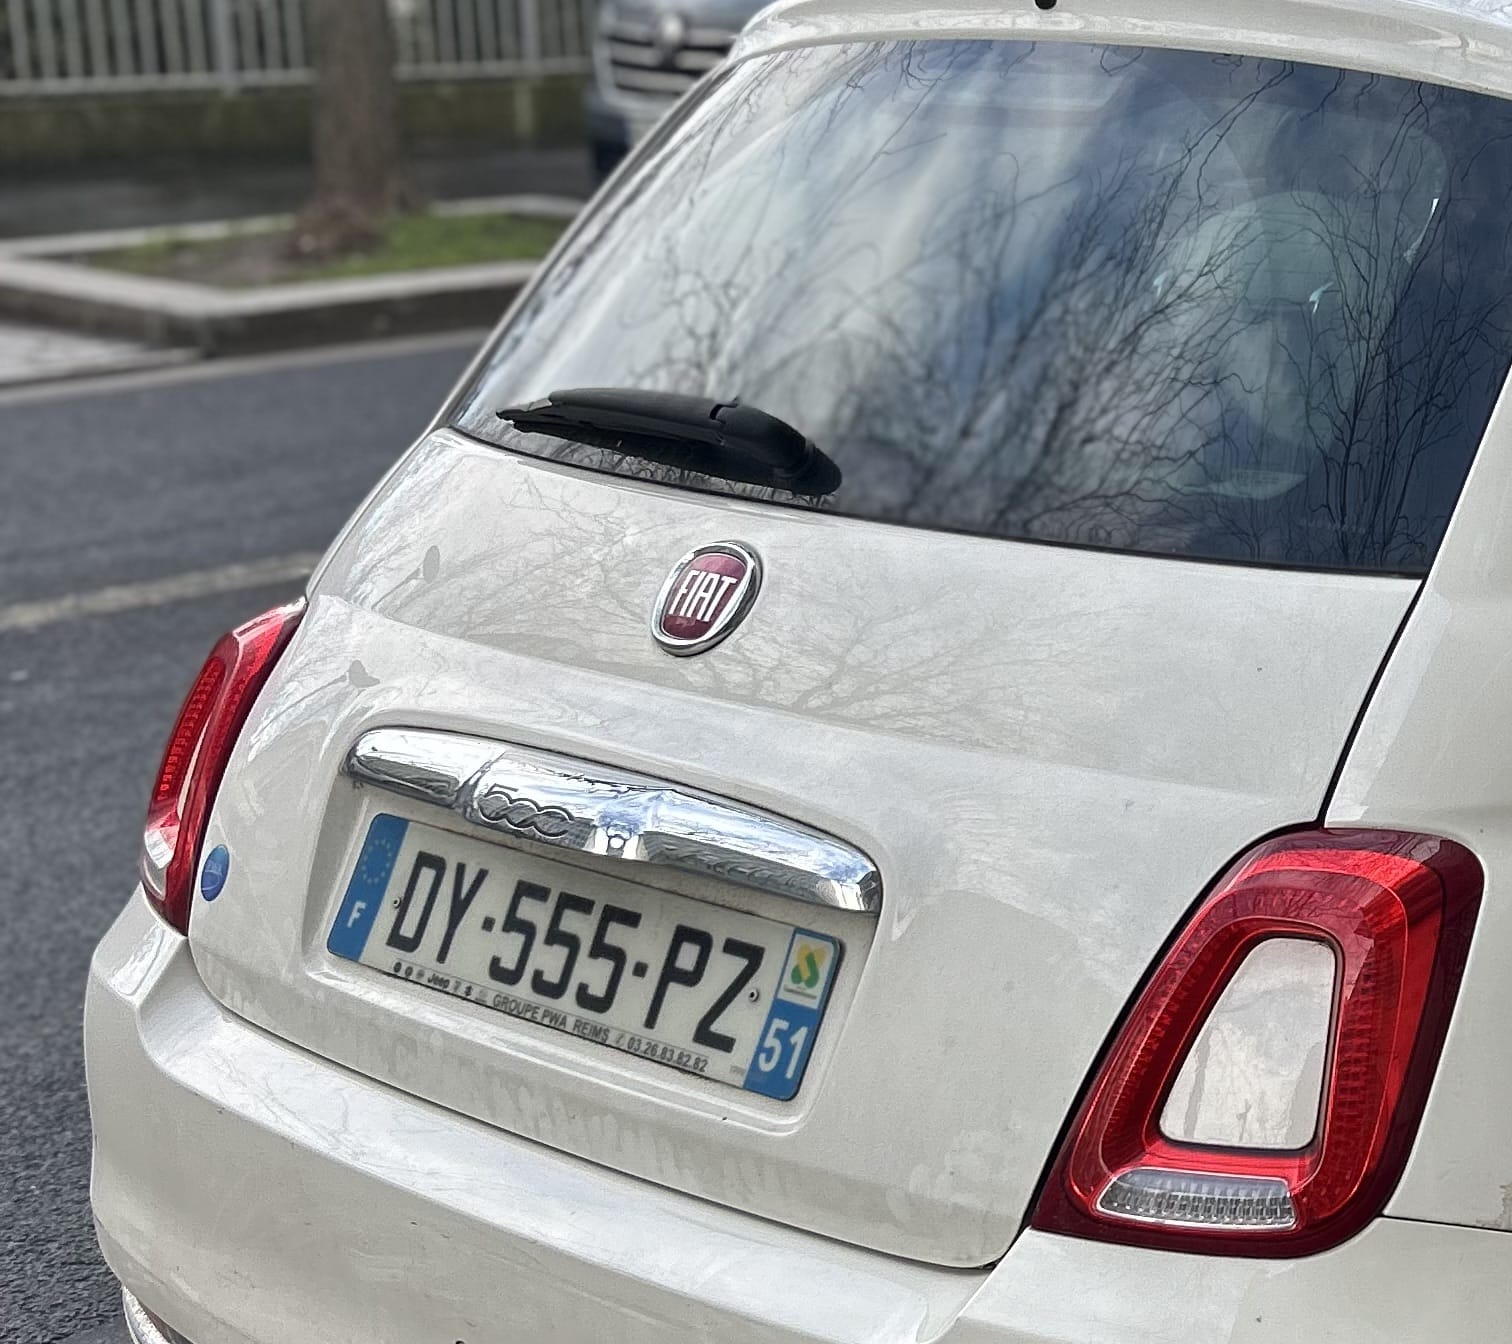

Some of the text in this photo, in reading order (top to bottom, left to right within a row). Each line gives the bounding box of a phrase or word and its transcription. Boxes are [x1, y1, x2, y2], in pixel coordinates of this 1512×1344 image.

[668, 570, 738, 622] FIAT
[478, 783, 576, 838] 500
[347, 901, 366, 928] F
[386, 851, 766, 1052] DY-555-PZ
[493, 994, 540, 1020] GROUPE
[541, 1009, 567, 1029] PWA
[573, 1019, 610, 1044] REIMS
[758, 1018, 809, 1079] 51
